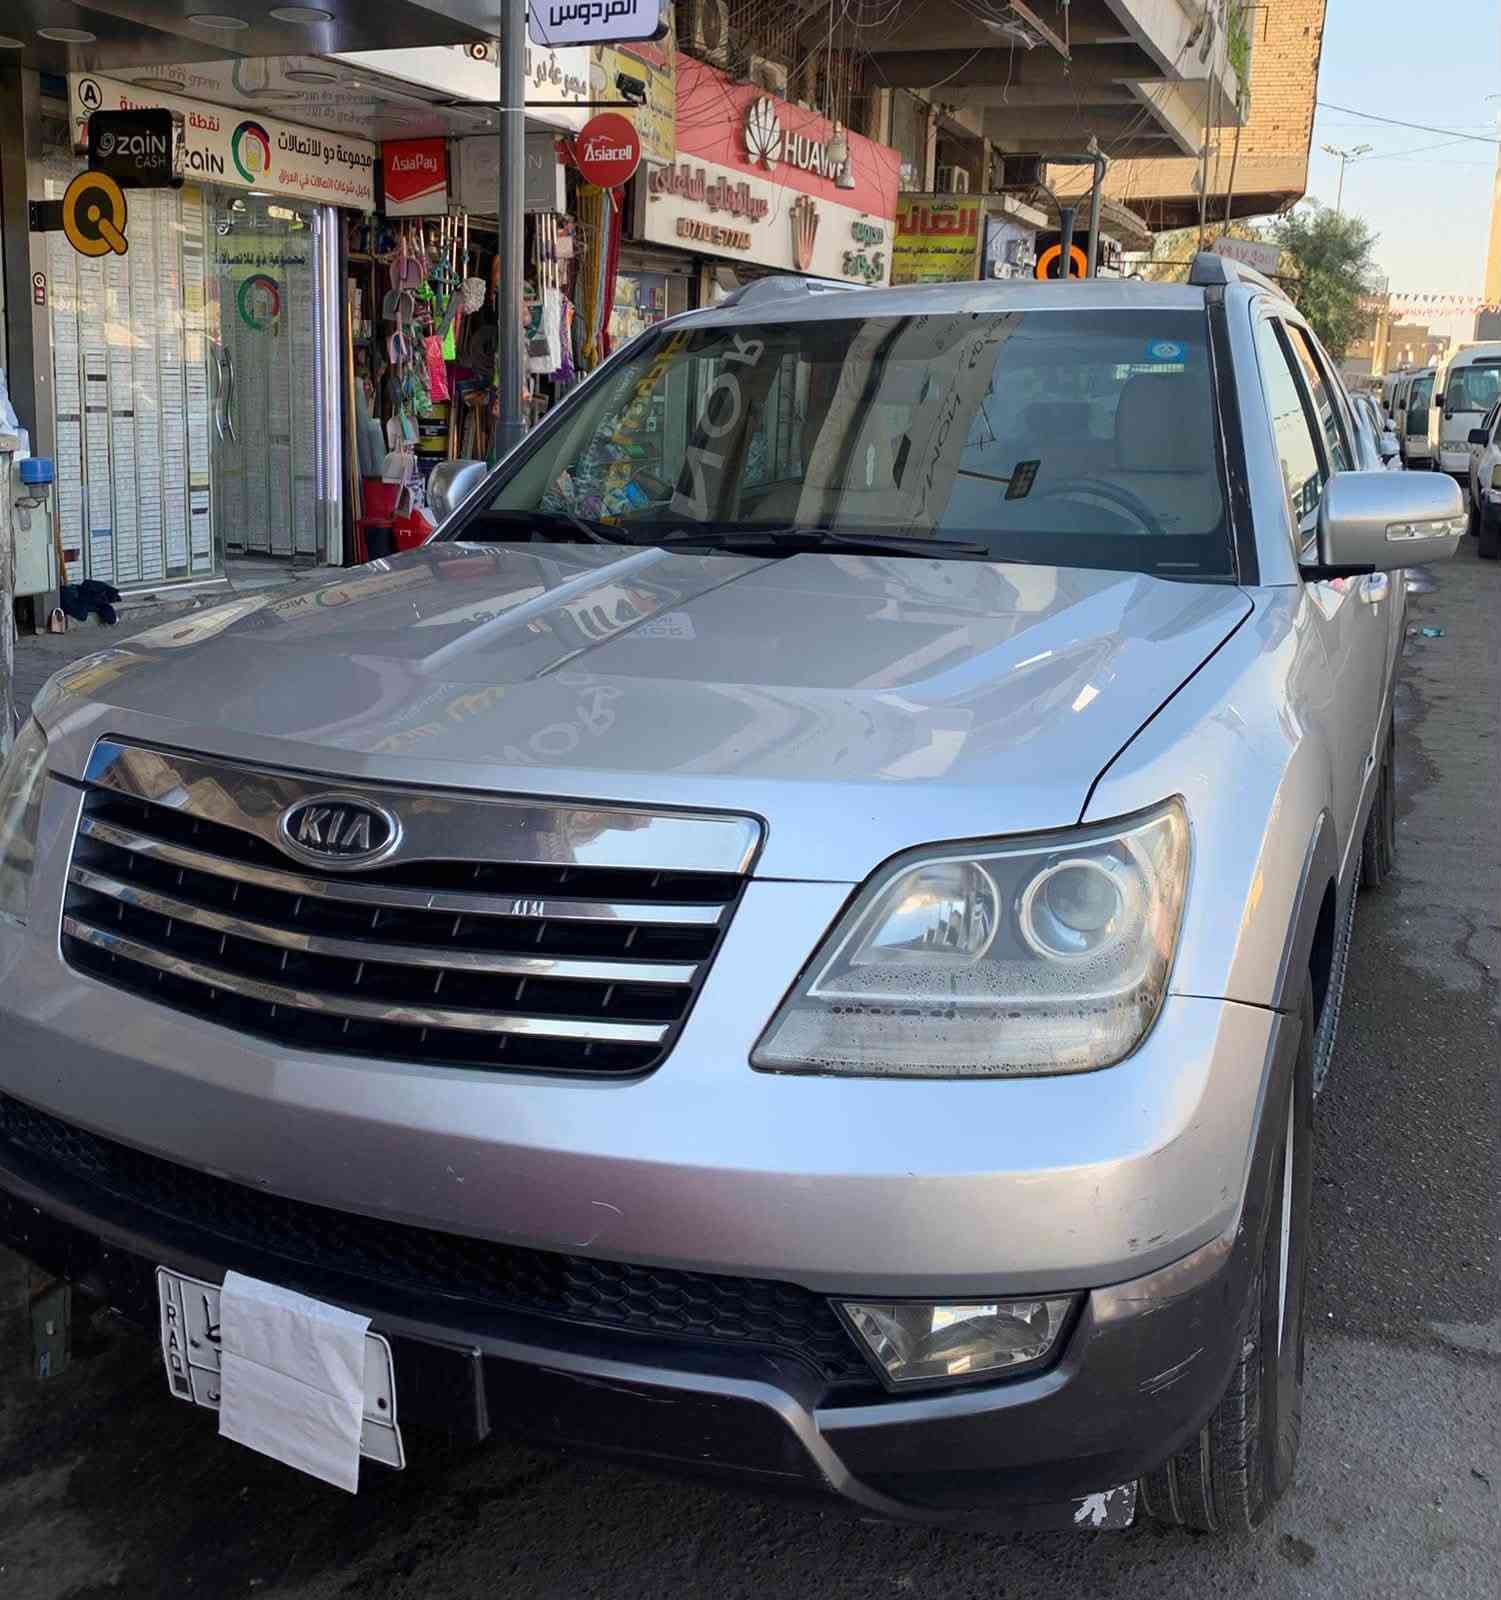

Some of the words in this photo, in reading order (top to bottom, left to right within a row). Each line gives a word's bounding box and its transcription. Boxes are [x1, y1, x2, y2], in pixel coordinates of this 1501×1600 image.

[189, 112, 220, 132] نقطة
[278, 131, 321, 157] للاتصالات
[584, 144, 633, 162] Asiacell
[785, 130, 844, 178] HUAW
[136, 155, 166, 168] CASH
[337, 144, 372, 173] مجموعة
[392, 153, 437, 172] AsiaPay
[299, 806, 371, 848] KIA
